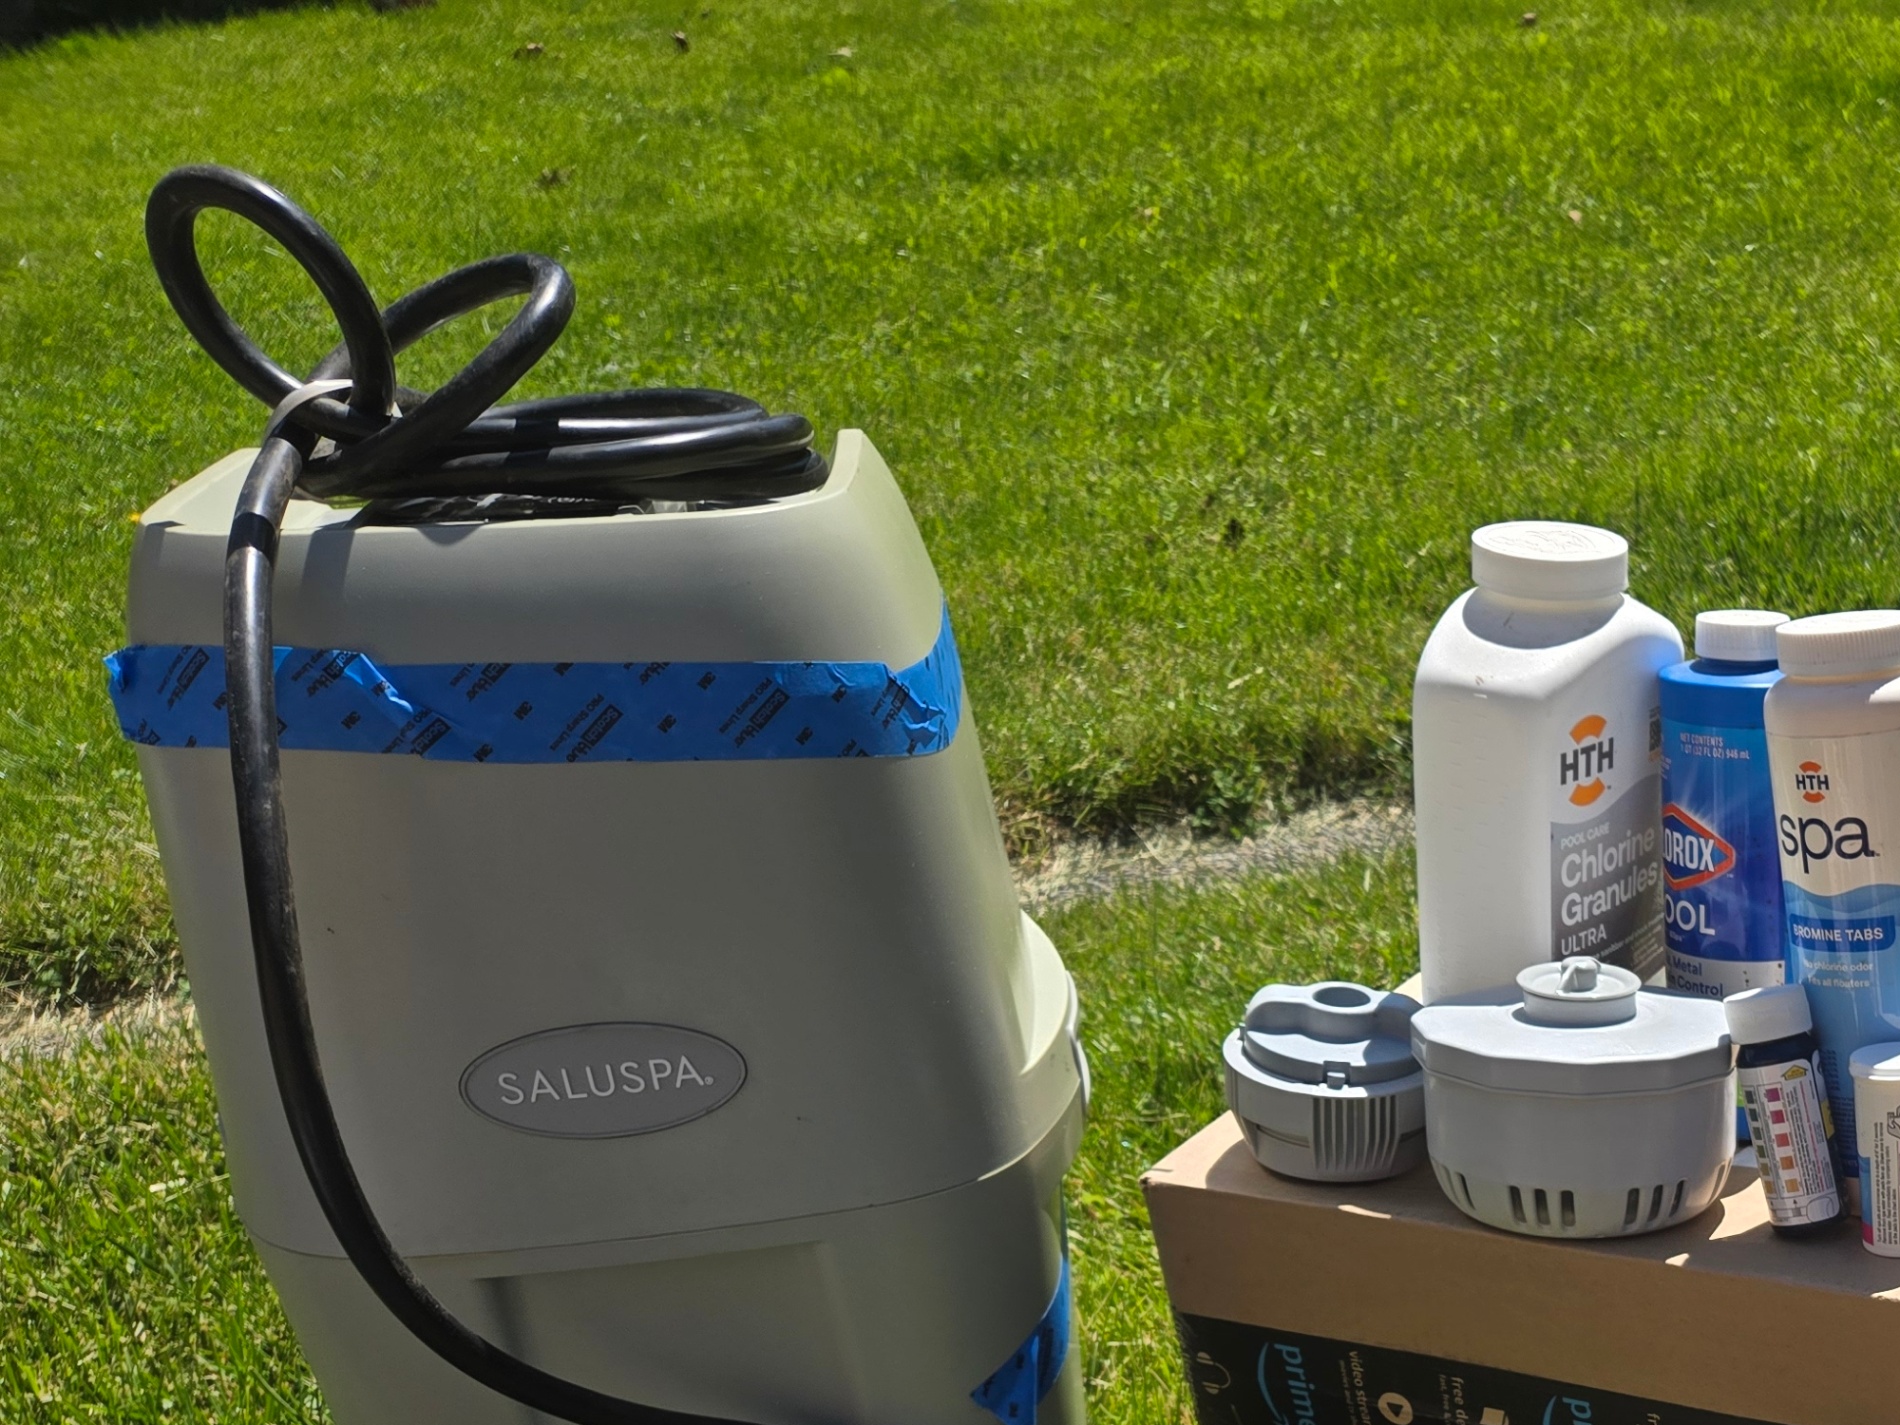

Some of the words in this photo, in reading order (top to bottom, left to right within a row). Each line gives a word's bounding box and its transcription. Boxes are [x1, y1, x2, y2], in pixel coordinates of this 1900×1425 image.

[584, 706, 619, 744] Scotch
[751, 690, 787, 727] Scotch
[1560, 737, 1614, 785] HTH
[1795, 774, 1830, 791] HTH
[1561, 827, 1655, 888] Chlorine
[1663, 827, 1716, 873] OROX
[1780, 814, 1875, 875] spa
[1561, 862, 1659, 927] Granules
[1664, 893, 1716, 936] OOL
[1793, 923, 1843, 942] BROMINE
[1844, 927, 1884, 942] TABS
[1561, 923, 1608, 956] ULTRA
[1849, 961, 1874, 971] odor
[1677, 974, 1724, 997] Control
[497, 1054, 705, 1106] SALUSPA
[1349, 1350, 1363, 1387] video
[1451, 1376, 1464, 1406] free
